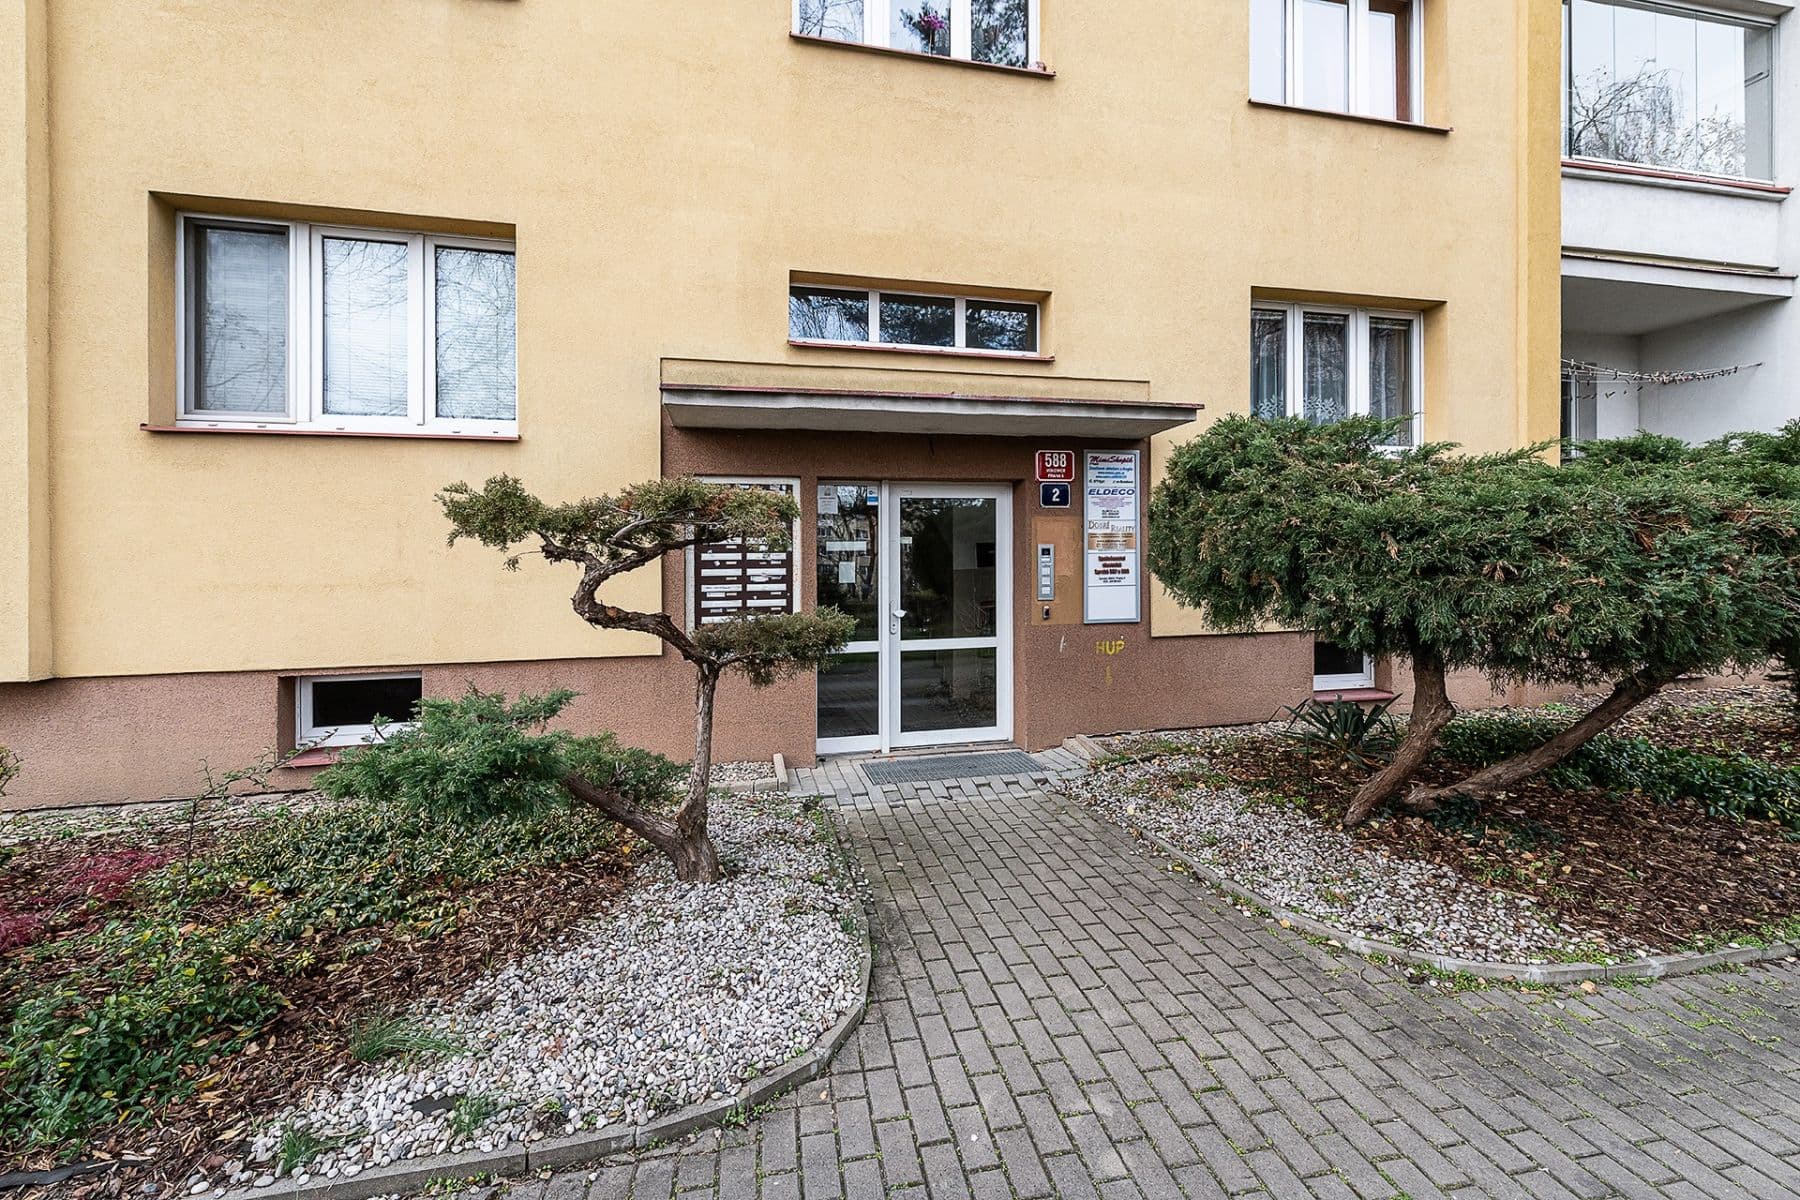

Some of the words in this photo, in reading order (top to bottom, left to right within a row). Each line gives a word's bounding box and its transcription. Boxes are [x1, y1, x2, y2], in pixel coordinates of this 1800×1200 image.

[1045, 453, 1067, 468] 588
[1052, 488, 1060, 502] 2
[1088, 488, 1135, 496] ELDECO
[1096, 640, 1125, 655] HUP
